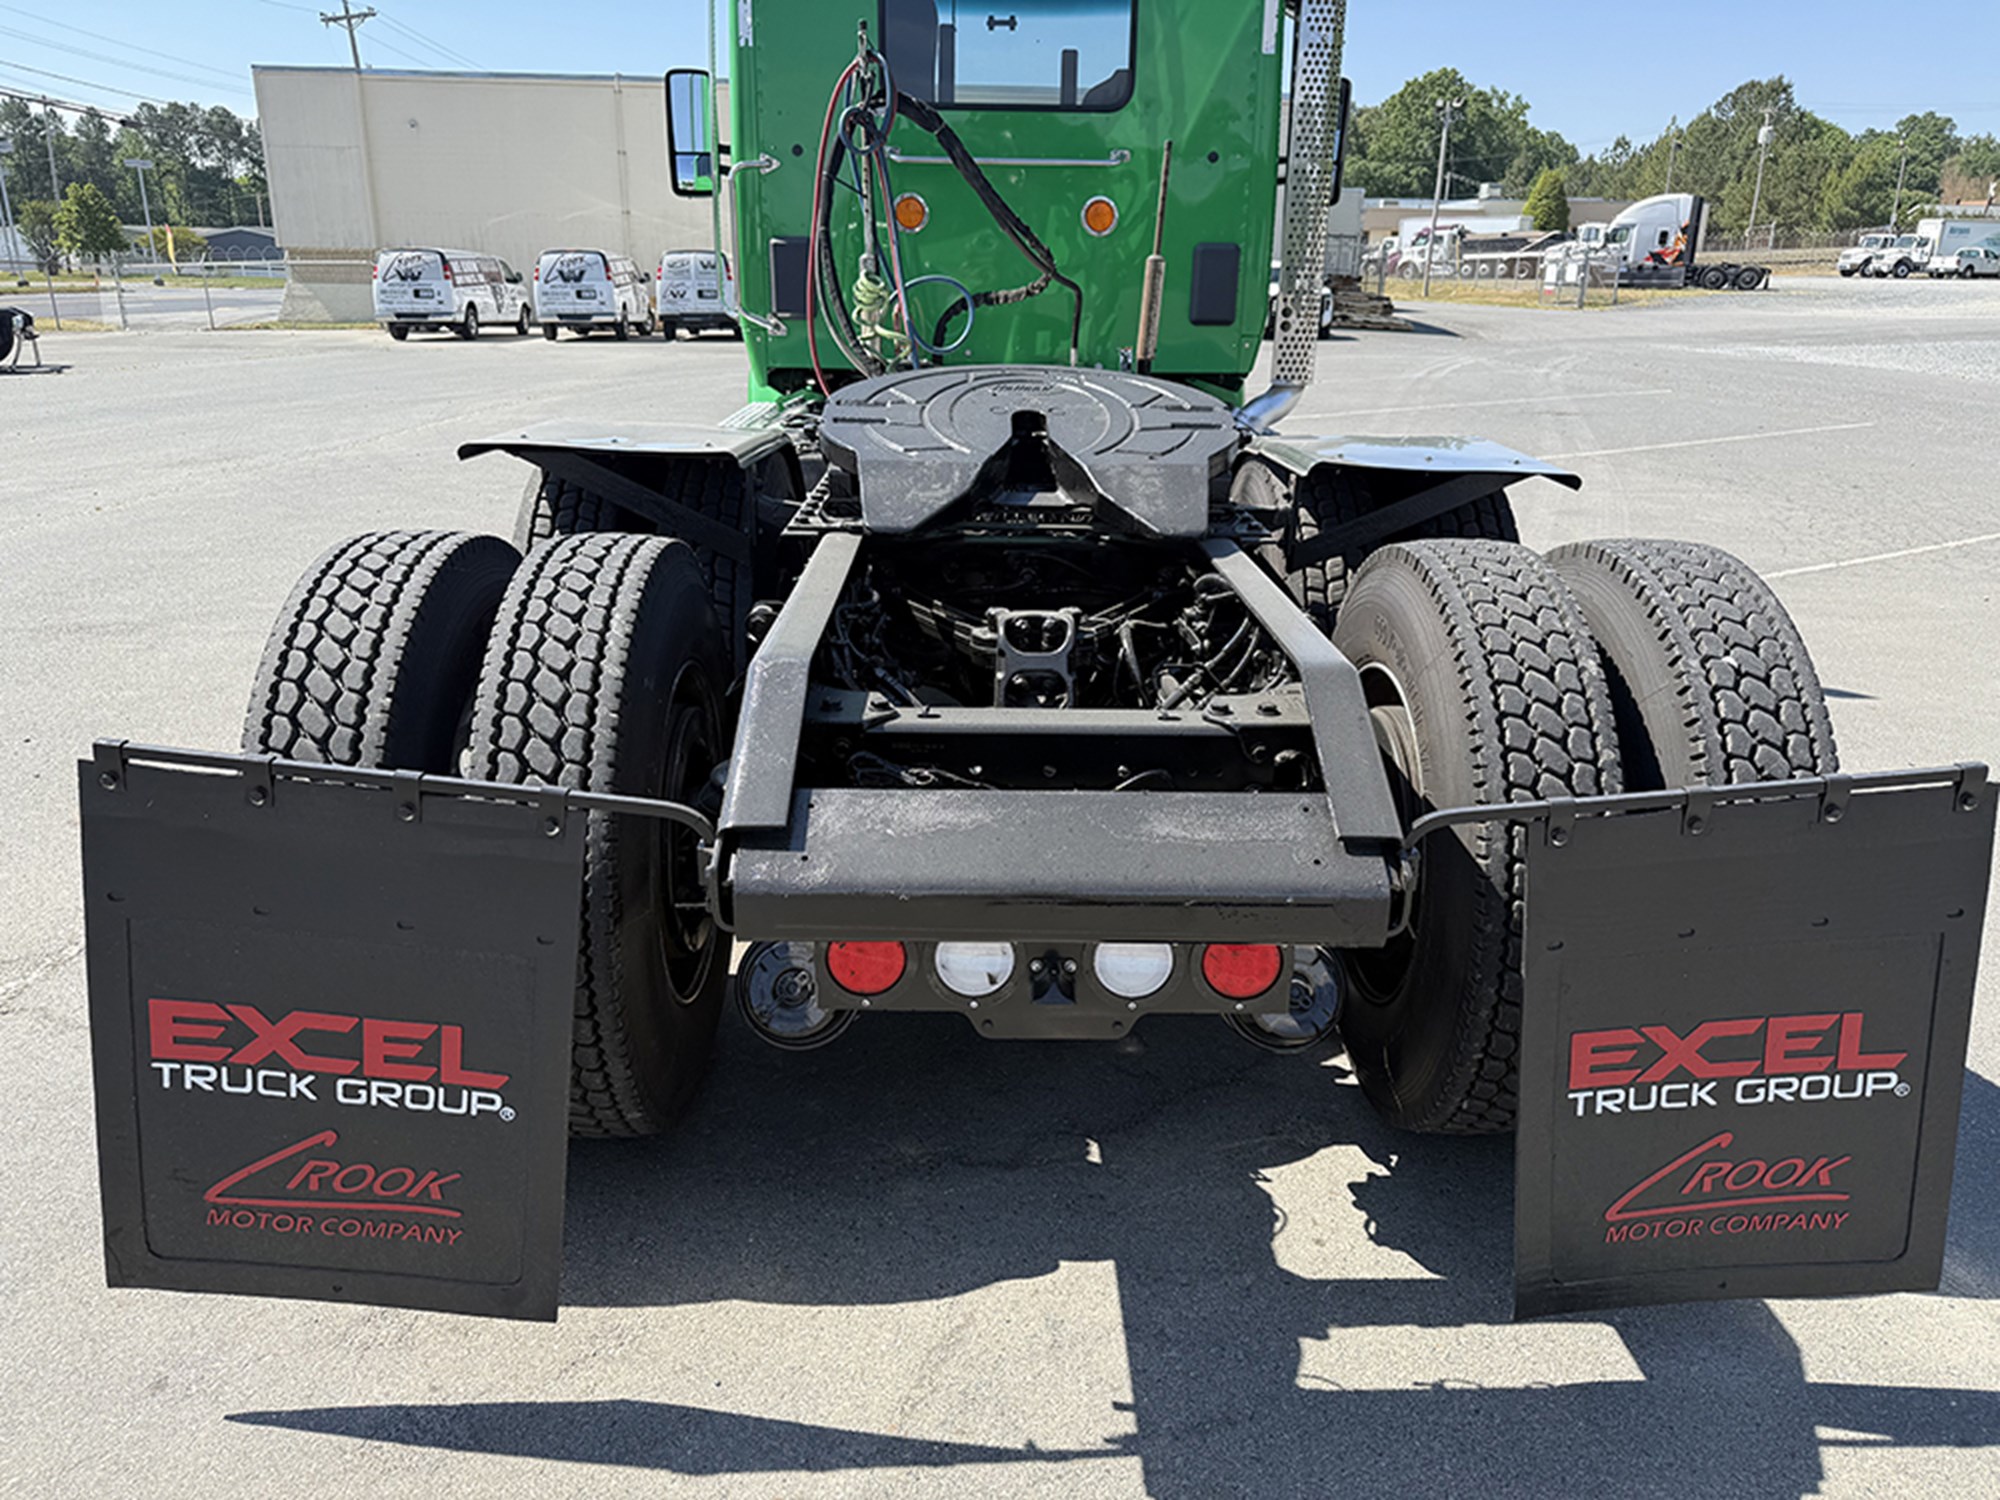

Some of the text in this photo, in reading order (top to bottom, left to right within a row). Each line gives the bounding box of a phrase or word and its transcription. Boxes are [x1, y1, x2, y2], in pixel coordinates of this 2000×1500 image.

[147, 998, 510, 1090] EXCEL
[1568, 1012, 1908, 1090] EXCEL
[151, 1062, 317, 1101] TRUCK
[1567, 1081, 1717, 1117] TRUCK
[206, 1209, 463, 1246] MOTOR COMPANY
[1604, 1212, 1850, 1244] MOTOR COMPANY
